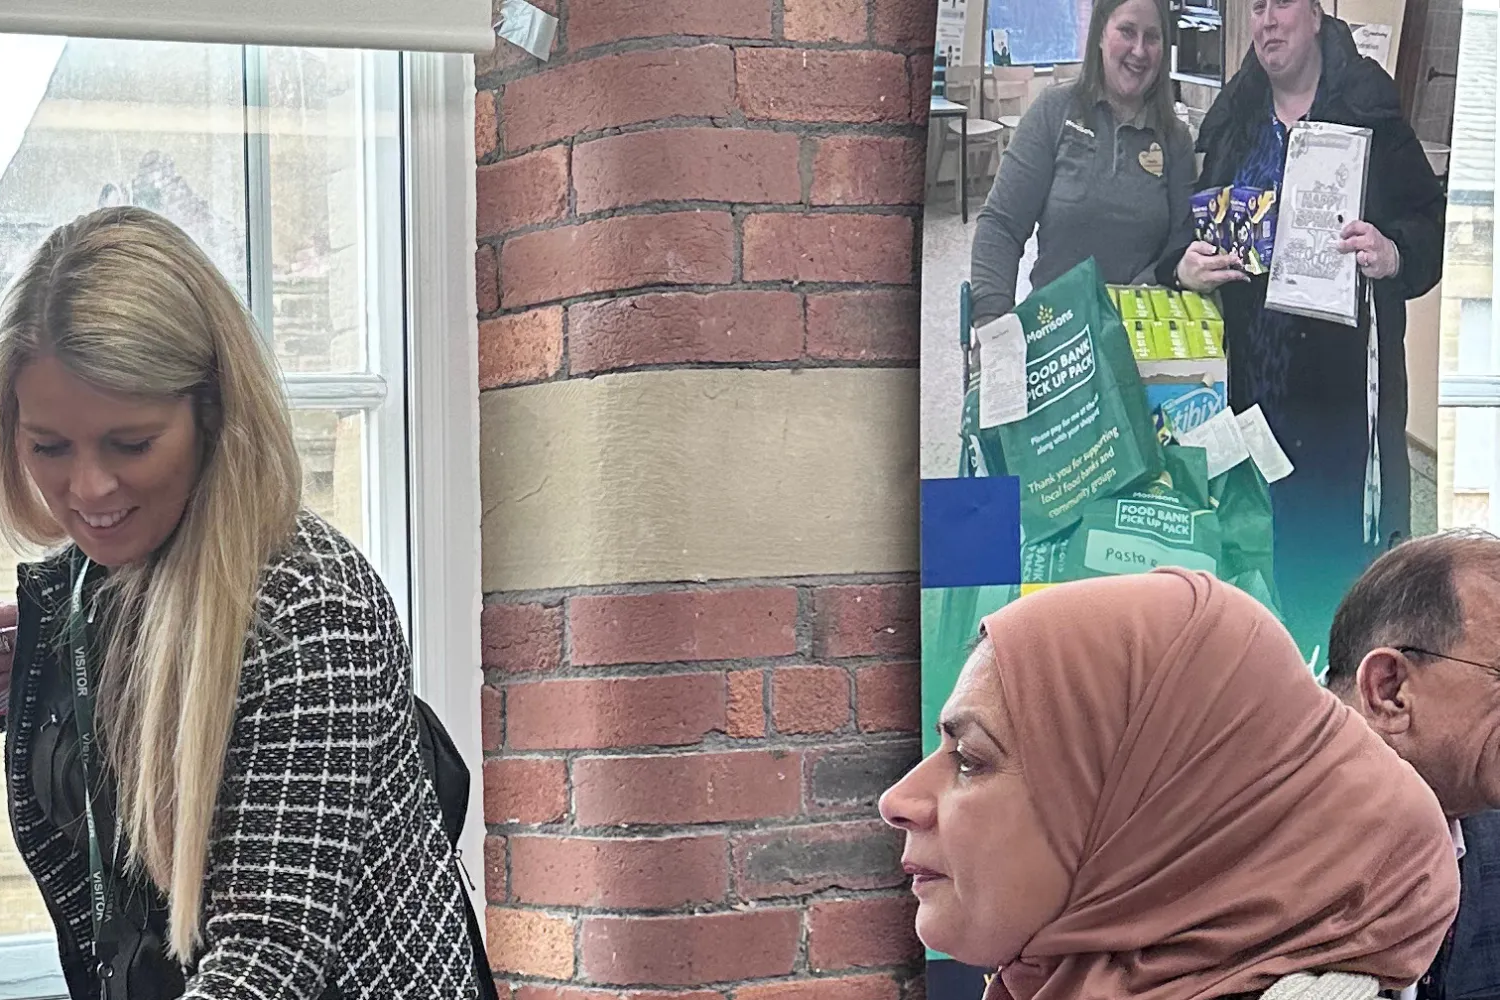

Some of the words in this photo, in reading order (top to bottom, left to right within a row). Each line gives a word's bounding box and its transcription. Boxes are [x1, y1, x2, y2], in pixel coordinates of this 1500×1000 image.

[1026, 309, 1074, 344] Morrisons
[1027, 360, 1059, 386] OOD
[1061, 337, 1091, 368] BANK
[1052, 371, 1068, 388] UP
[1069, 353, 1093, 378] PACK
[1028, 473, 1056, 494] Thank
[1055, 465, 1072, 479] you
[1072, 456, 1083, 470] for
[1083, 426, 1119, 461] supporting
[1041, 485, 1062, 504] local
[1063, 473, 1081, 493] food
[1080, 461, 1100, 480] banks
[1100, 445, 1115, 465] and
[1048, 486, 1090, 519] community
[1091, 467, 1117, 494] groups
[1121, 504, 1155, 517] FOOD
[1157, 509, 1190, 524] BANK
[1120, 514, 1145, 525] PICK
[1146, 516, 1162, 528] UP
[1162, 522, 1190, 536] PACK
[1105, 547, 1146, 565] Pasta
[74, 646, 88, 697] VISITOR
[93, 870, 106, 922] VISITOR
